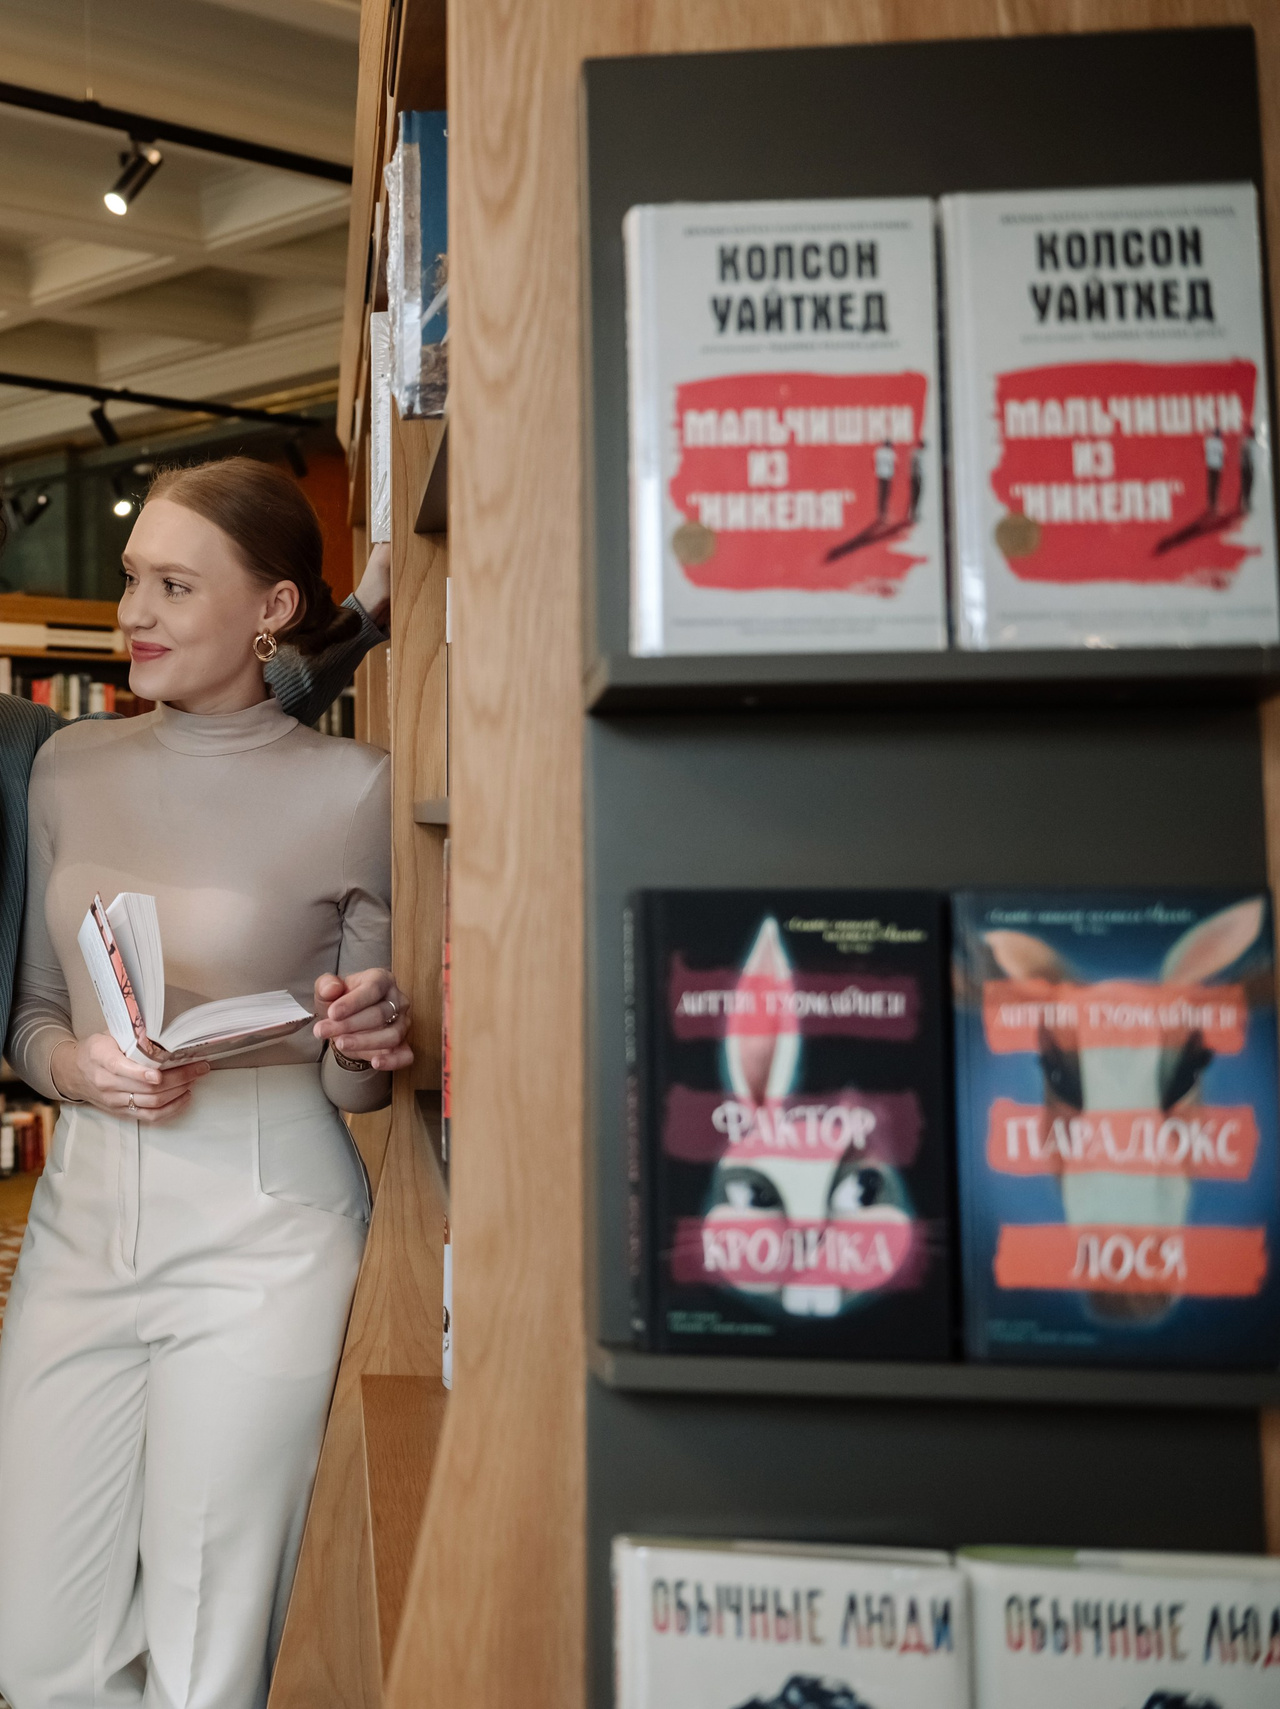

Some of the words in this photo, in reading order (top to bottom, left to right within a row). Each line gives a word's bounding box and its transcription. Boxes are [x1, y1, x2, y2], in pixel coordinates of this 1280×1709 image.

[718, 240, 877, 282] КОЛСОН
[1037, 225, 1202, 271] КОЛСОН
[712, 286, 888, 334] УАЙТХЕД
[1030, 276, 1216, 323] УАЙТХЕД
[683, 405, 914, 447] МАЛЬЧИШКИ
[1005, 392, 1241, 439] МАЛЬЧИШКИ
[747, 450, 788, 488] ИЗ
[1072, 440, 1114, 479] ИЗ
[712, 1101, 876, 1150] ФАКТОР
[1005, 1116, 1242, 1166] ПАРАДОКС
[702, 1227, 894, 1275] КРОЛИКА
[1072, 1233, 1187, 1283] ЛОСЯ
[652, 1578, 823, 1645] ОБЫЧНЫЕ
[841, 1591, 956, 1656] ЛЮДИ
[1005, 1594, 1187, 1661] ОБЫЧНЫЕ
